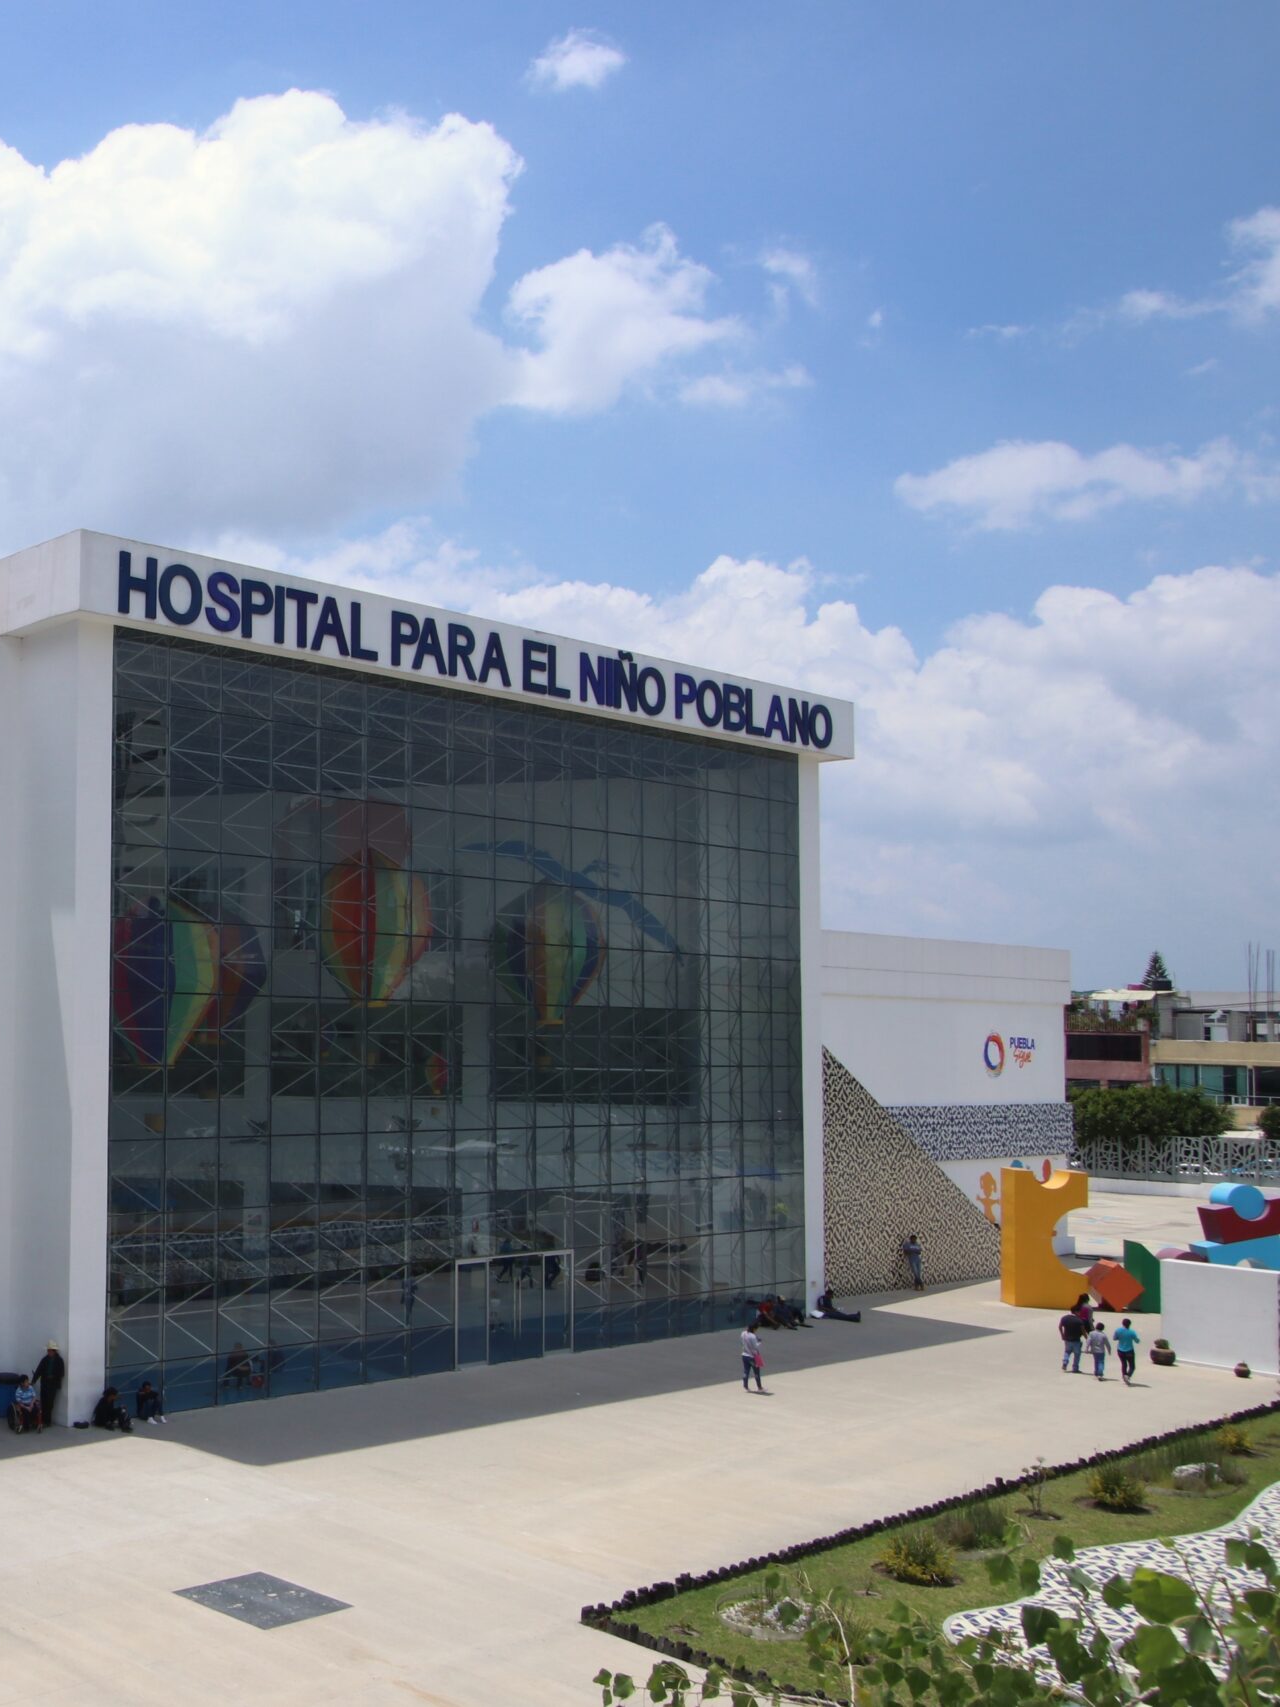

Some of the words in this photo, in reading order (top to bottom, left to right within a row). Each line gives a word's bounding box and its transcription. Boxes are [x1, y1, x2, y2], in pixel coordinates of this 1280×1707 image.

[118, 550, 378, 661] HOSPITAL
[391, 610, 511, 687] PARA
[523, 639, 571, 698] EL
[579, 650, 666, 716] NIÑO
[674, 672, 833, 749] POBLANO
[1009, 1037, 1035, 1049] PUEBLA
